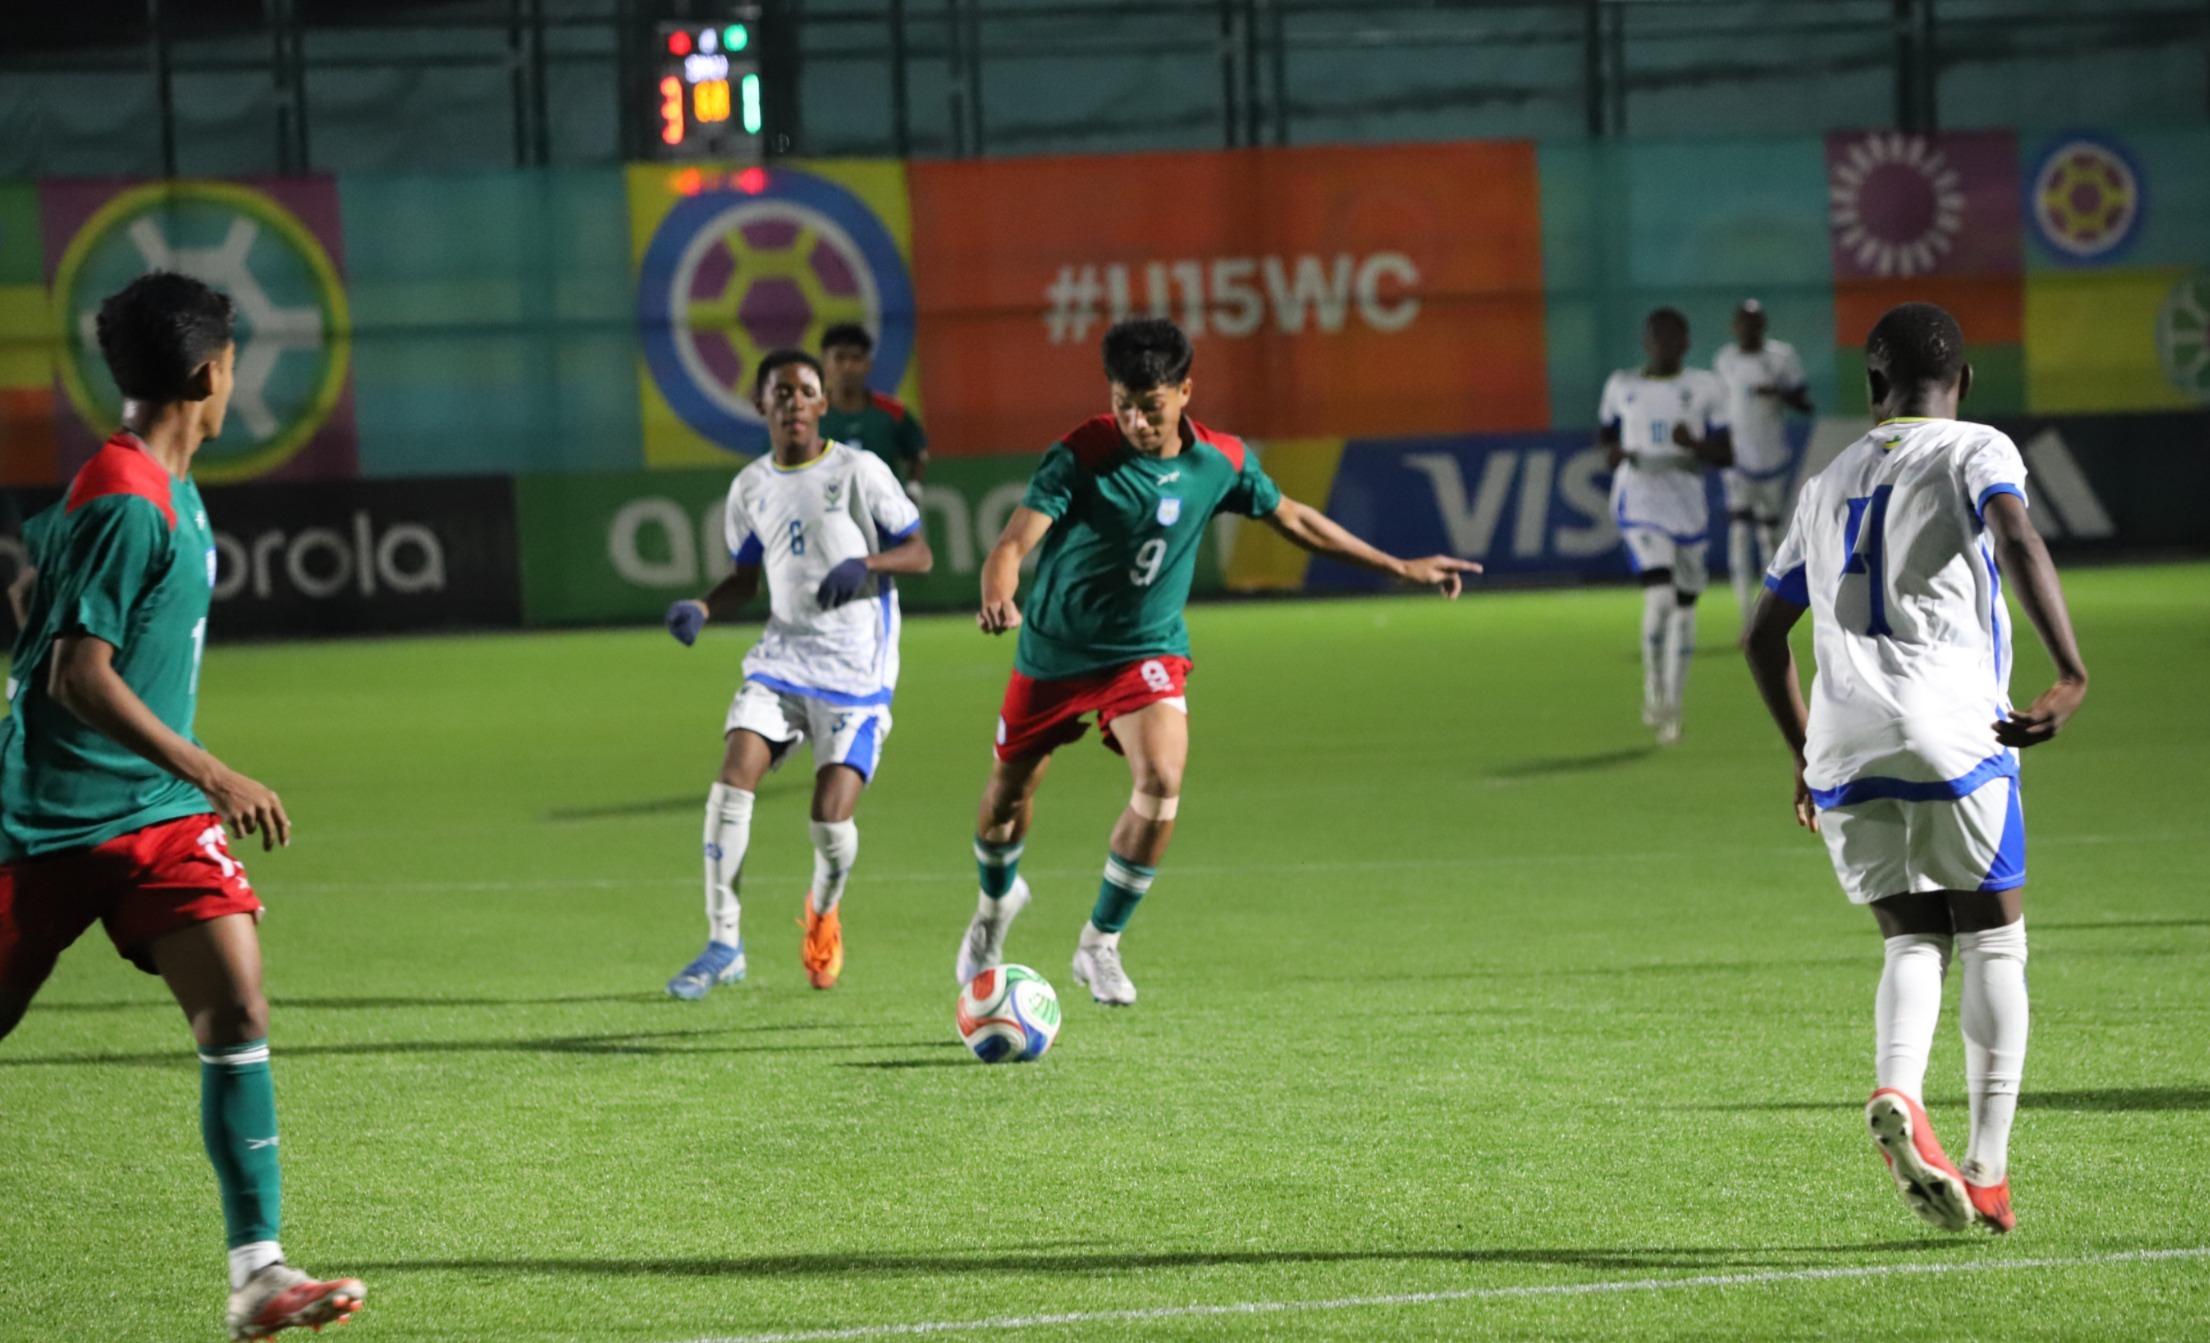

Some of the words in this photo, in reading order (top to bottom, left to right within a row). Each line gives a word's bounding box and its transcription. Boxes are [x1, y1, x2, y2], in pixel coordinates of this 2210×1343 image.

[1044, 251, 1422, 346] #U15WC
[788, 519, 805, 557] 8
[1401, 447, 1622, 560] VIS
[1129, 538, 1168, 587] 9
